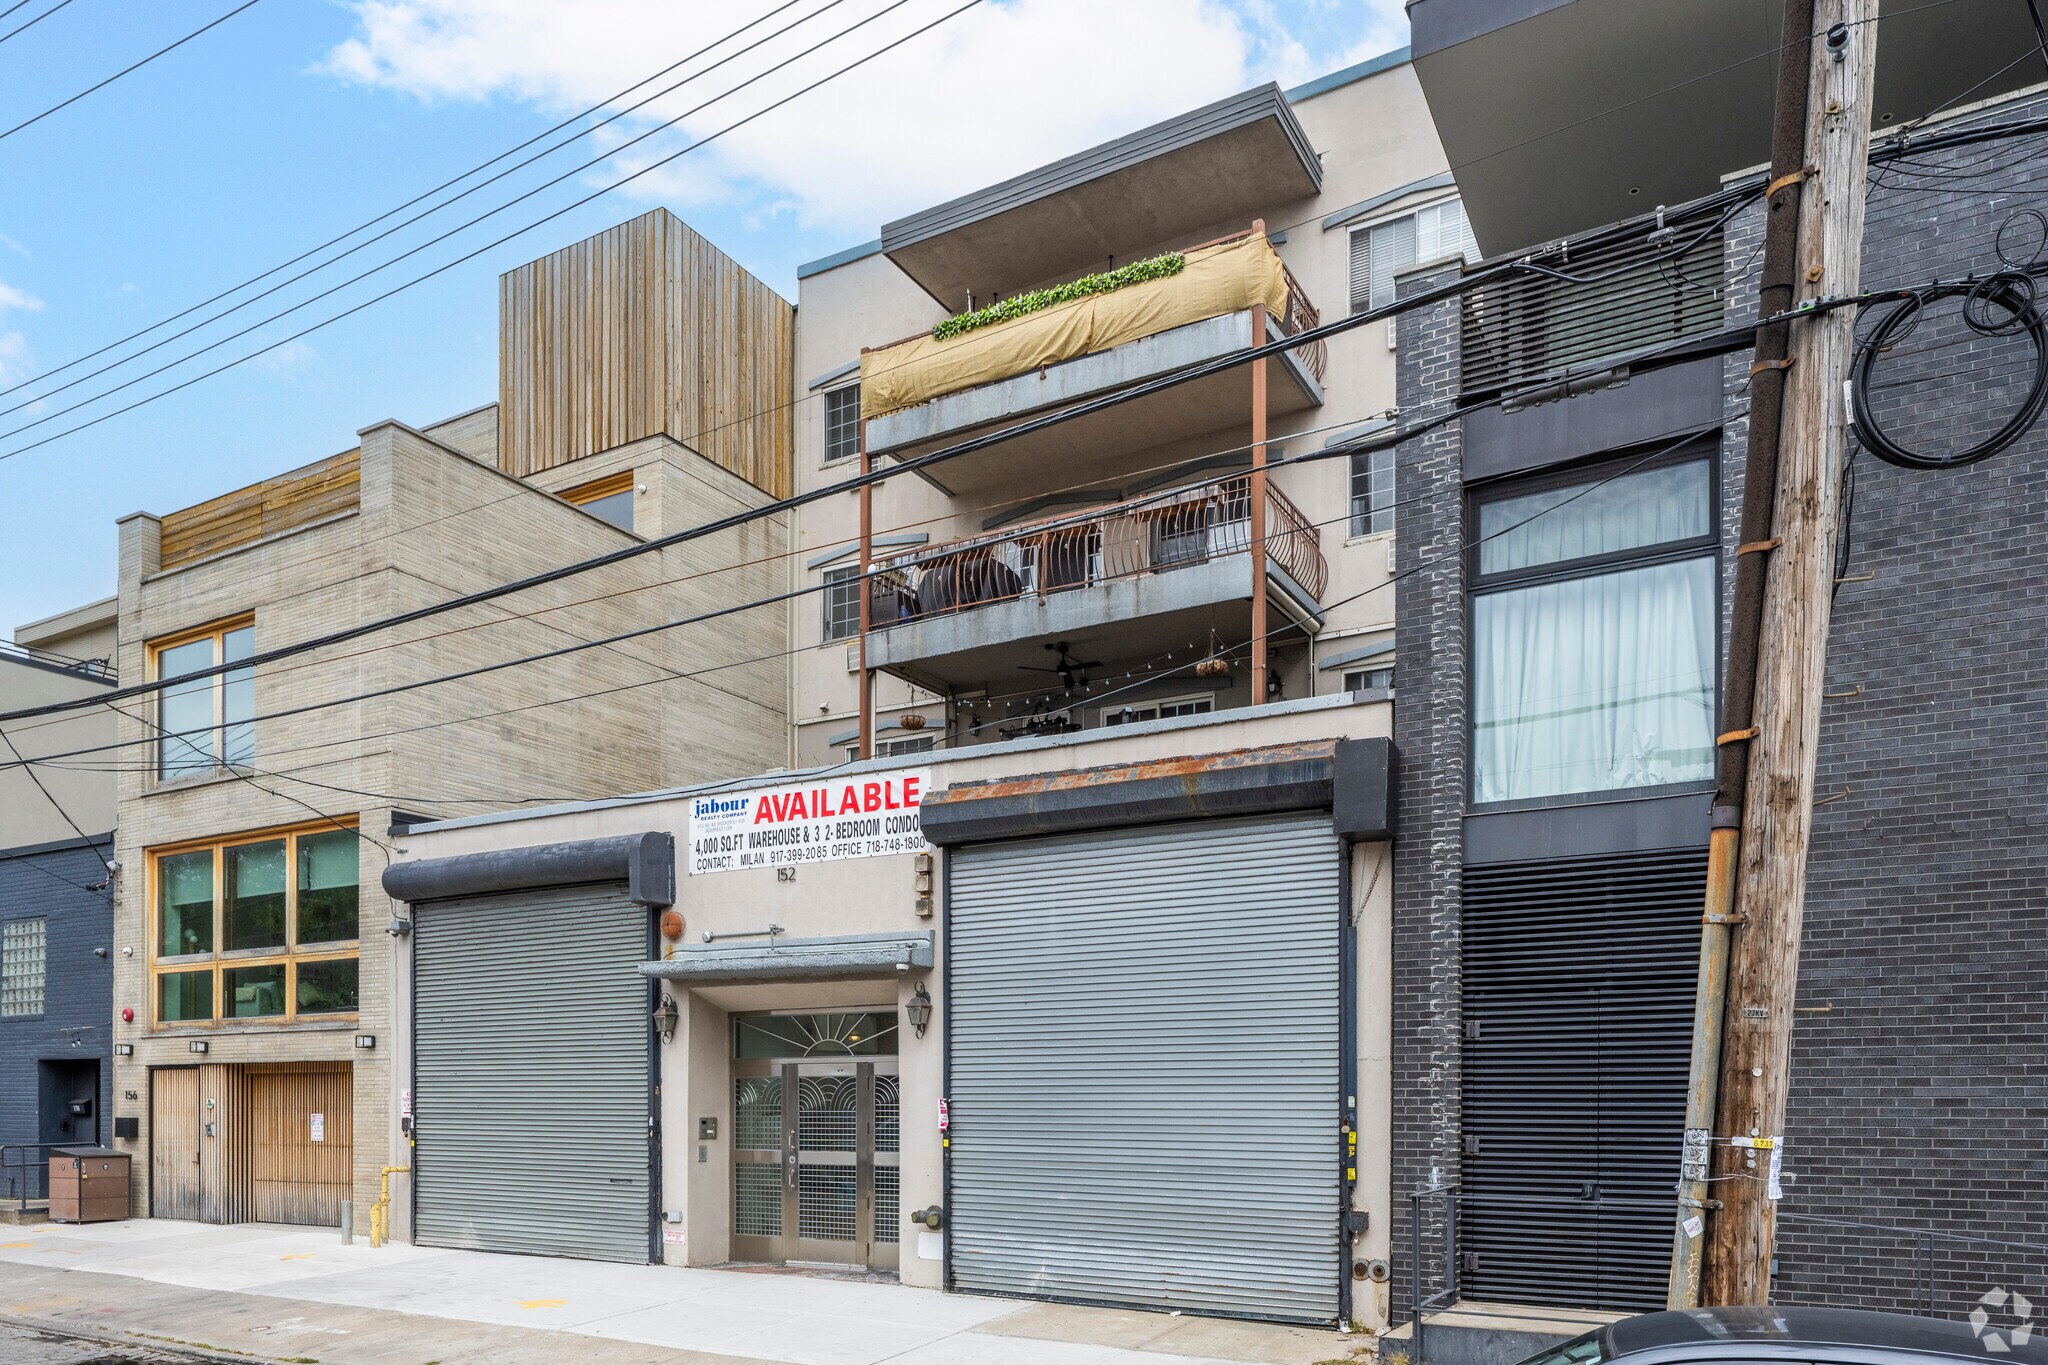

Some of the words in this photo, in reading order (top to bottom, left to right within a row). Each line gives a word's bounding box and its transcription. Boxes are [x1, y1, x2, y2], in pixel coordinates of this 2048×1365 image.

[694, 798, 749, 819] jabour
[754, 777, 920, 825] AVAILABLE
[722, 811, 748, 819] COMPANY
[695, 837, 718, 857] 4,000
[720, 833, 743, 852] SQ.FT
[748, 826, 801, 849] WAREHOUSE
[803, 826, 810, 843] &
[814, 825, 820, 842] 3
[836, 818, 880, 840] BEDROOM
[696, 855, 734, 871] CONTACT:
[740, 851, 765, 866] MILAN
[770, 845, 827, 863] 917-399-2085
[831, 842, 861, 857] OFFICE
[866, 836, 926, 854] 718-748-1800
[776, 867, 797, 882] 152
[125, 1090, 138, 1100] 156
